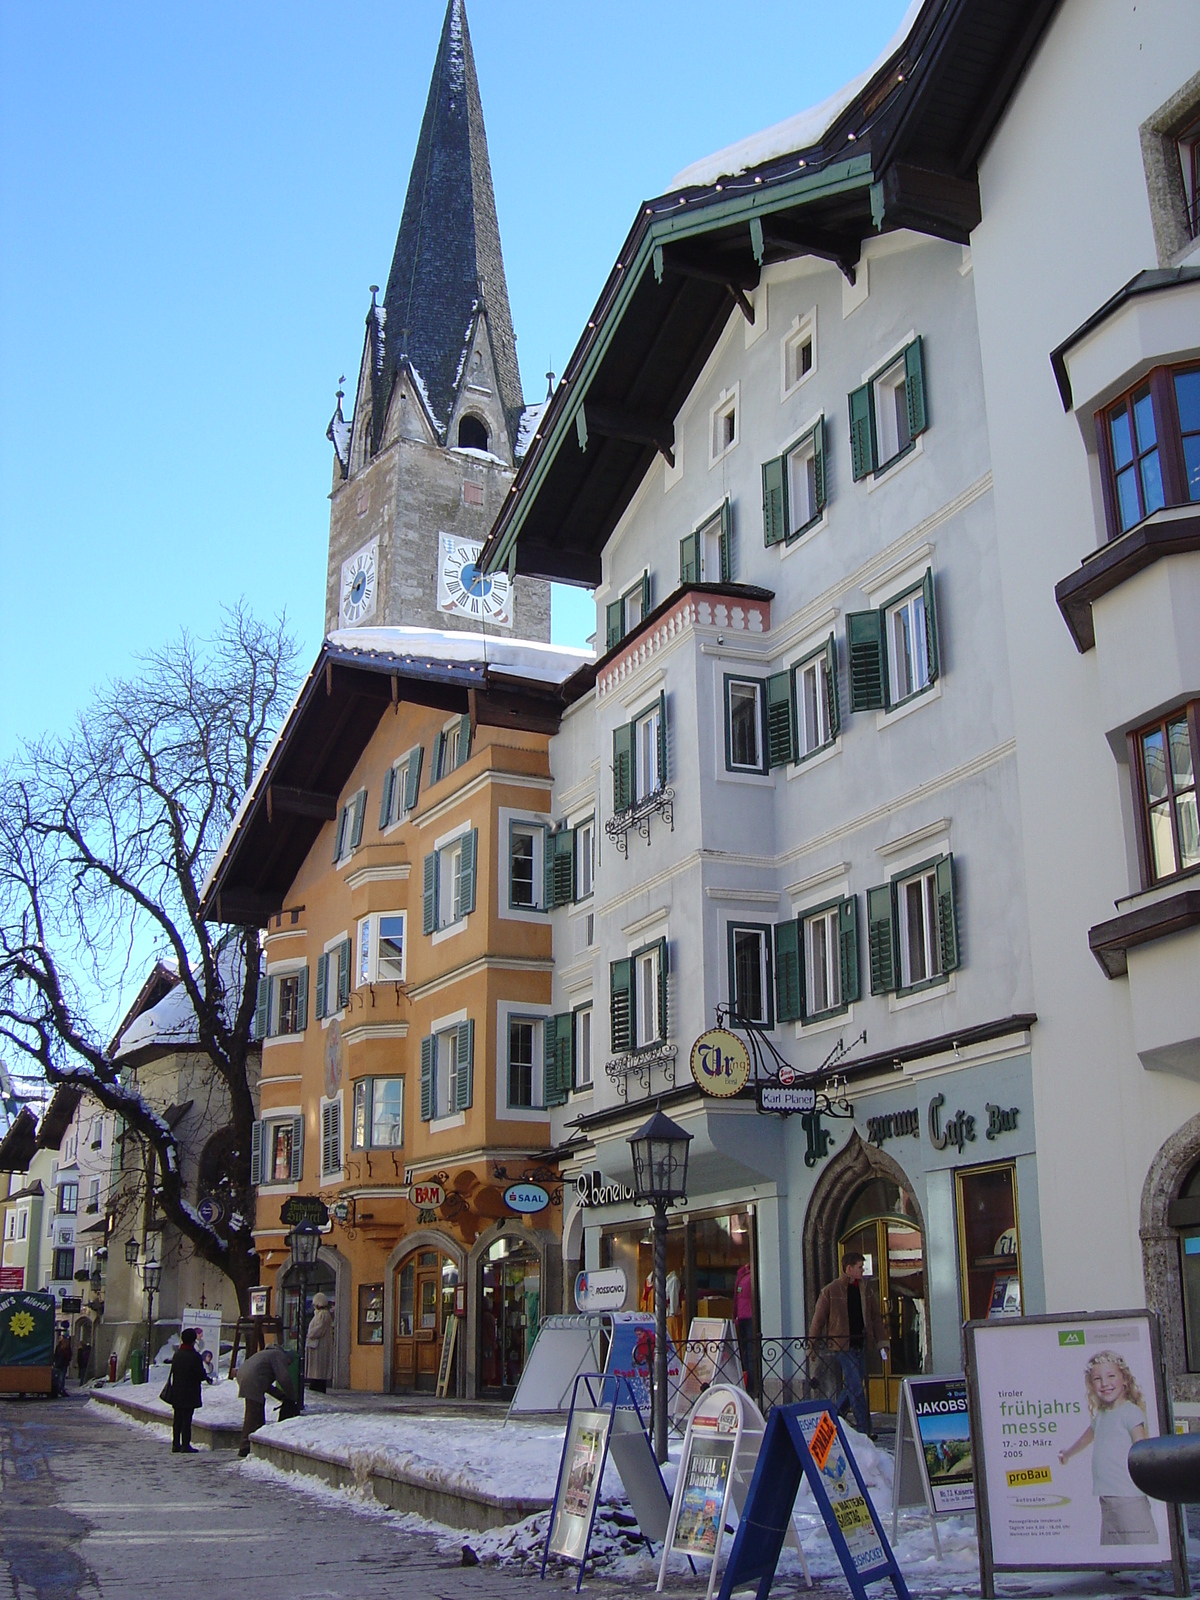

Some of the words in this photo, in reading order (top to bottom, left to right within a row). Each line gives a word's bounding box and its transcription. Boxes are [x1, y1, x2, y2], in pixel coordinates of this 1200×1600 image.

[763, 1093, 781, 1104] Karl
[784, 1093, 813, 1105] Planer
[985, 1102, 1020, 1141] Bar
[518, 1193, 544, 1204] SAAL
[594, 1284, 625, 1296] ROSSIGNOL
[998, 1390, 1023, 1398] tiroler
[999, 1399, 1081, 1419] frühjahrs
[1002, 1421, 1057, 1435] messe
[811, 1416, 834, 1465] FINALE
[1032, 1439, 1052, 1447] März
[1003, 1450, 1023, 1458] 2005
[692, 1456, 717, 1475] ROYAL
[689, 1474, 719, 1489] Dancing
[1008, 1469, 1048, 1485] proBau
[852, 1546, 884, 1568] EISHOCKEY
